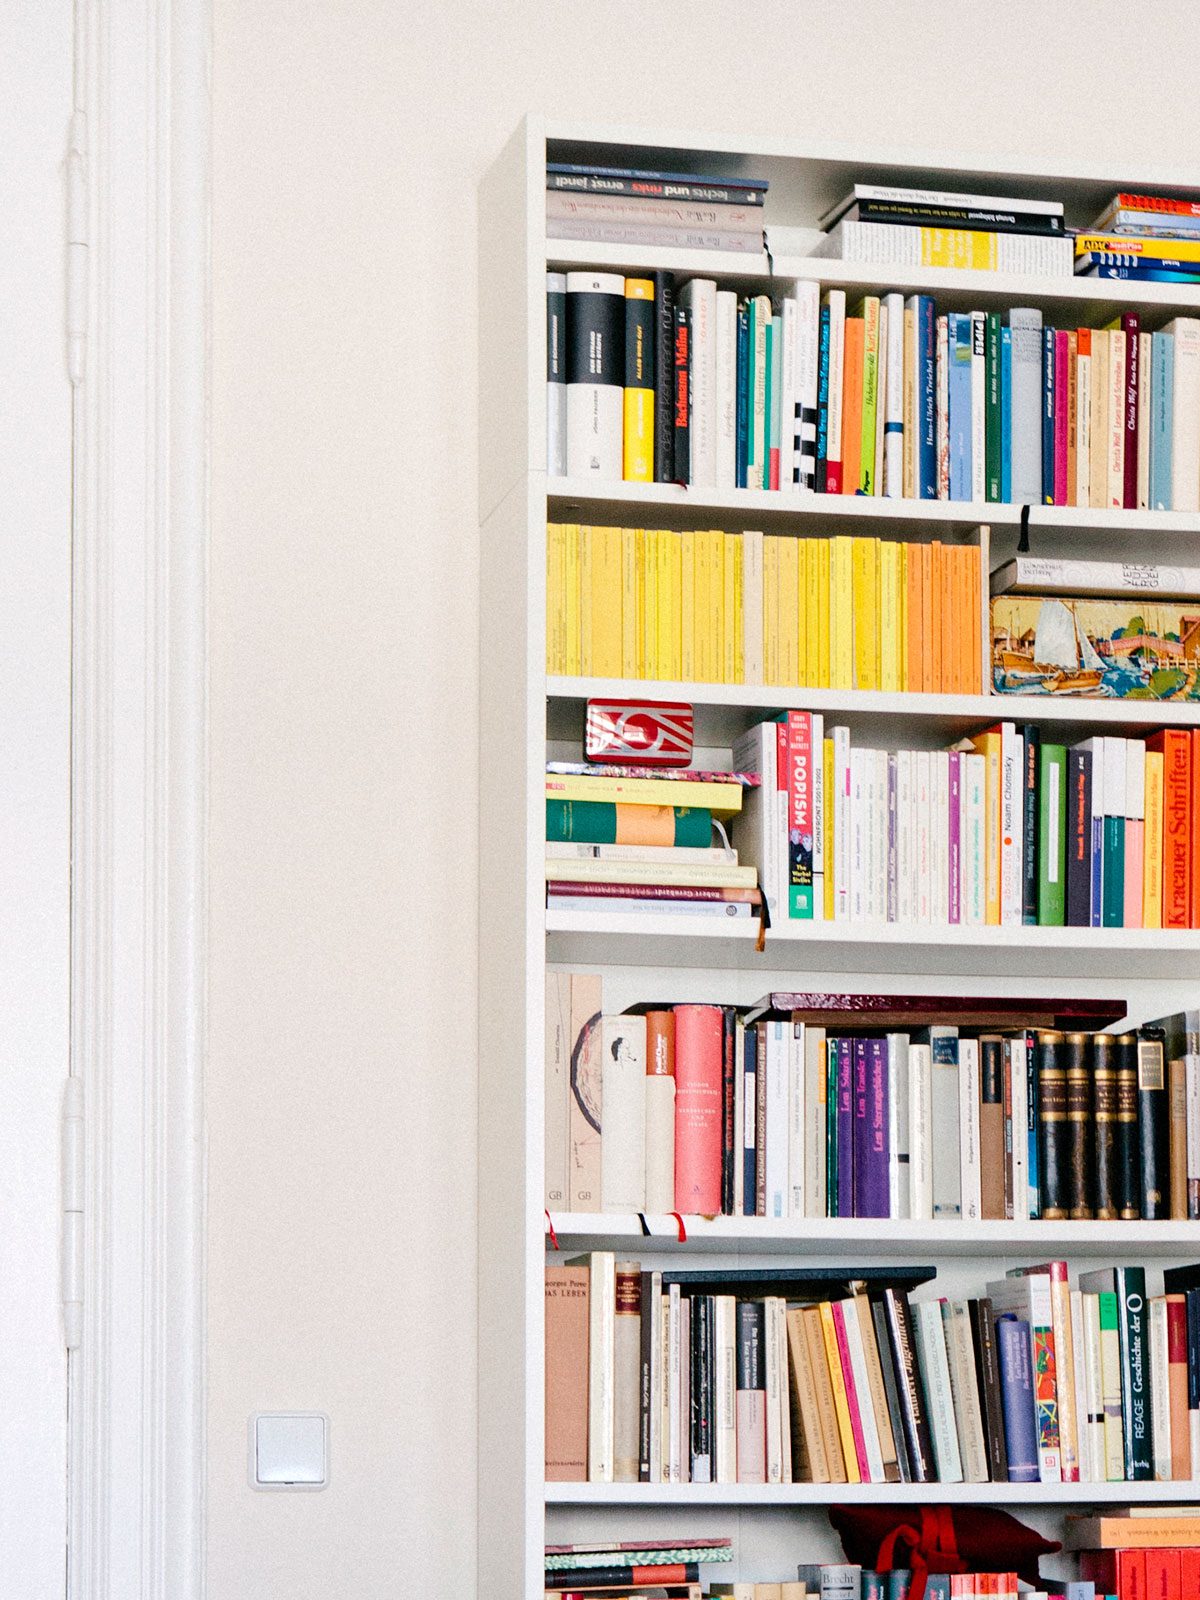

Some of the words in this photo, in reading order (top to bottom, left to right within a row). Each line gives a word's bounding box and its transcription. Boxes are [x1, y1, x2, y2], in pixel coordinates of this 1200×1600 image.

[556, 177, 588, 189] jandl
[591, 180, 624, 190] ernst
[632, 183, 662, 196] rinks
[666, 186, 690, 196] und
[693, 189, 728, 200] lechts
[660, 289, 671, 330] ruhm
[676, 327, 687, 366] Malina
[866, 334, 875, 352] Karl
[974, 320, 984, 355] PIPER
[676, 371, 687, 428] Bachmann
[780, 728, 786, 737] 27
[794, 756, 807, 825] POPISM
[1003, 756, 1013, 800] Chomsky
[1167, 748, 1186, 836] Schriften
[1003, 804, 1011, 831] Noam
[1168, 840, 1186, 926] Kracauer
[840, 1058, 850, 1088] Solaris
[856, 1060, 866, 1093] Transfer
[841, 1093, 850, 1112] Lem
[857, 1100, 865, 1118] Lem
[874, 1132, 883, 1152] Lem
[1126, 1294, 1142, 1313] O
[1130, 1315, 1141, 1333] der
[895, 1301, 913, 1375] Jugendwerke
[1130, 1336, 1142, 1393] Geschichte
[1131, 1400, 1144, 1440] RÉAGE
[823, 1574, 853, 1584] Brecht
